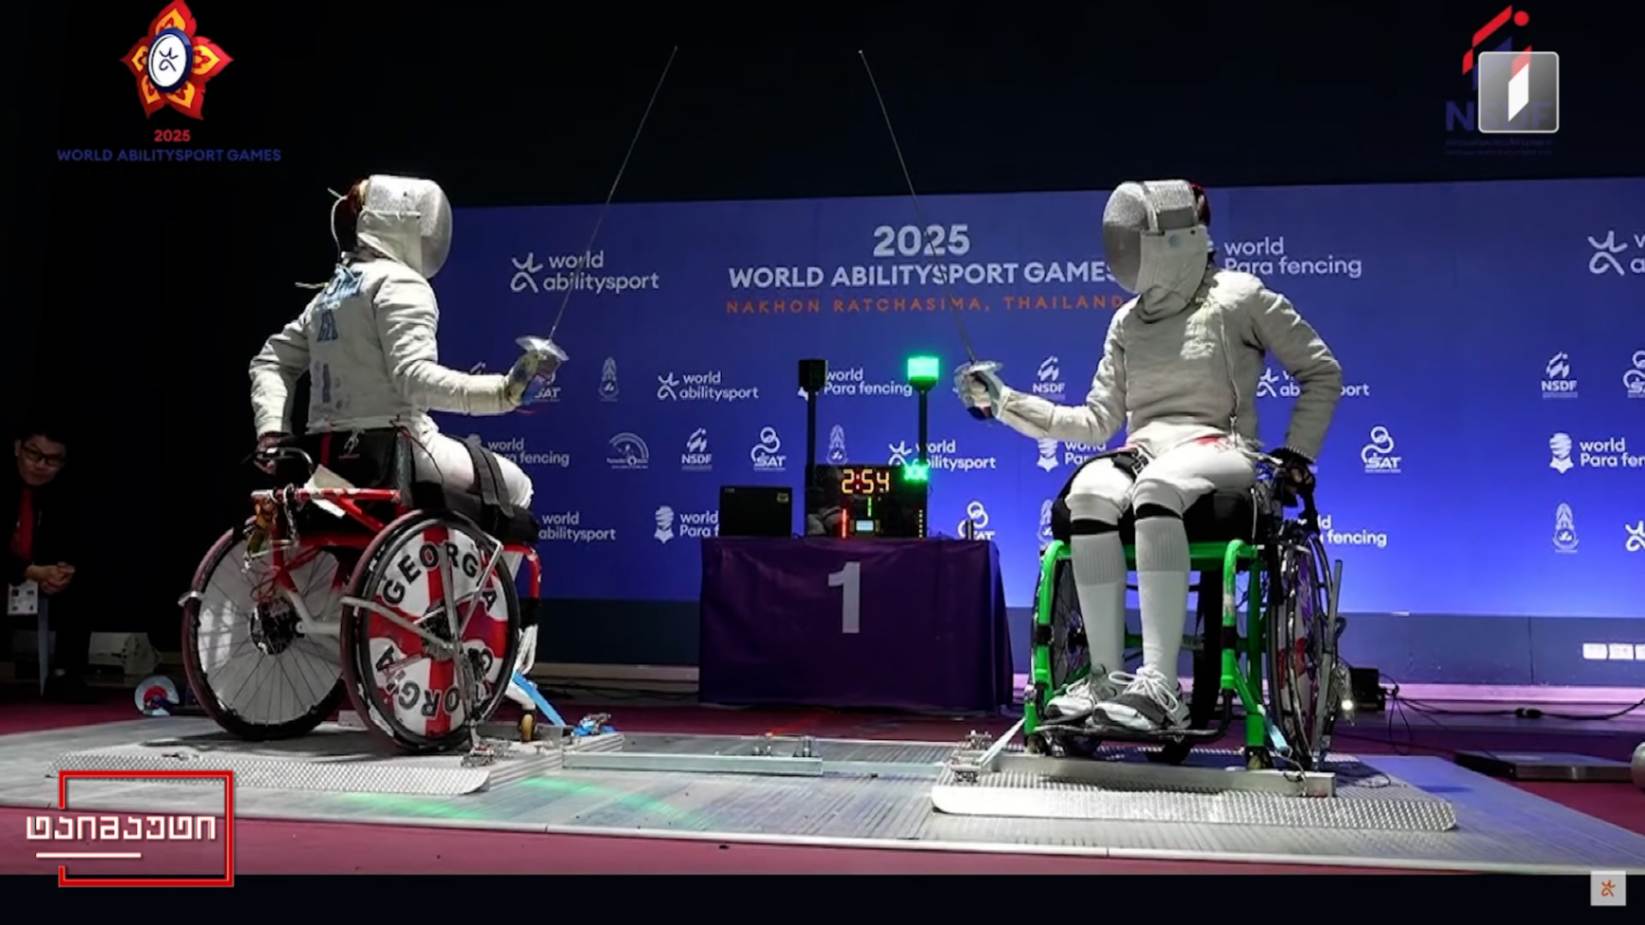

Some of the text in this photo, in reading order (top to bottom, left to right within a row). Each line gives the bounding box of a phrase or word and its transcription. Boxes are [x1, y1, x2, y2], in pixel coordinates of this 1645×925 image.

[873, 224, 970, 257] 2025
[1224, 236, 1284, 256] world
[549, 250, 604, 269] world
[1278, 254, 1362, 278] fencing
[543, 271, 660, 294] abilitysport
[729, 266, 823, 289] WORLD
[831, 263, 1018, 287] ABILITYSPORT
[726, 295, 1122, 314] NAKHON RATCHASIMA, THAILAND
[682, 371, 721, 384] world
[1541, 380, 1578, 392] NSDF
[679, 384, 760, 402] abilitysport
[824, 380, 913, 398] Para fencing
[1032, 383, 1065, 393] NSDF
[487, 437, 525, 451] world
[1579, 437, 1626, 453] world
[520, 450, 570, 468] fencing
[681, 453, 712, 465] NSDF
[912, 454, 996, 473] ilitysport
[1580, 452, 1618, 468] Para
[841, 468, 890, 494] 2:54
[542, 511, 580, 525] world
[680, 510, 719, 524] world
[538, 526, 616, 543] abilitysport
[680, 524, 712, 539] Para
[1327, 529, 1387, 548] fencing
[828, 561, 861, 634] 1
